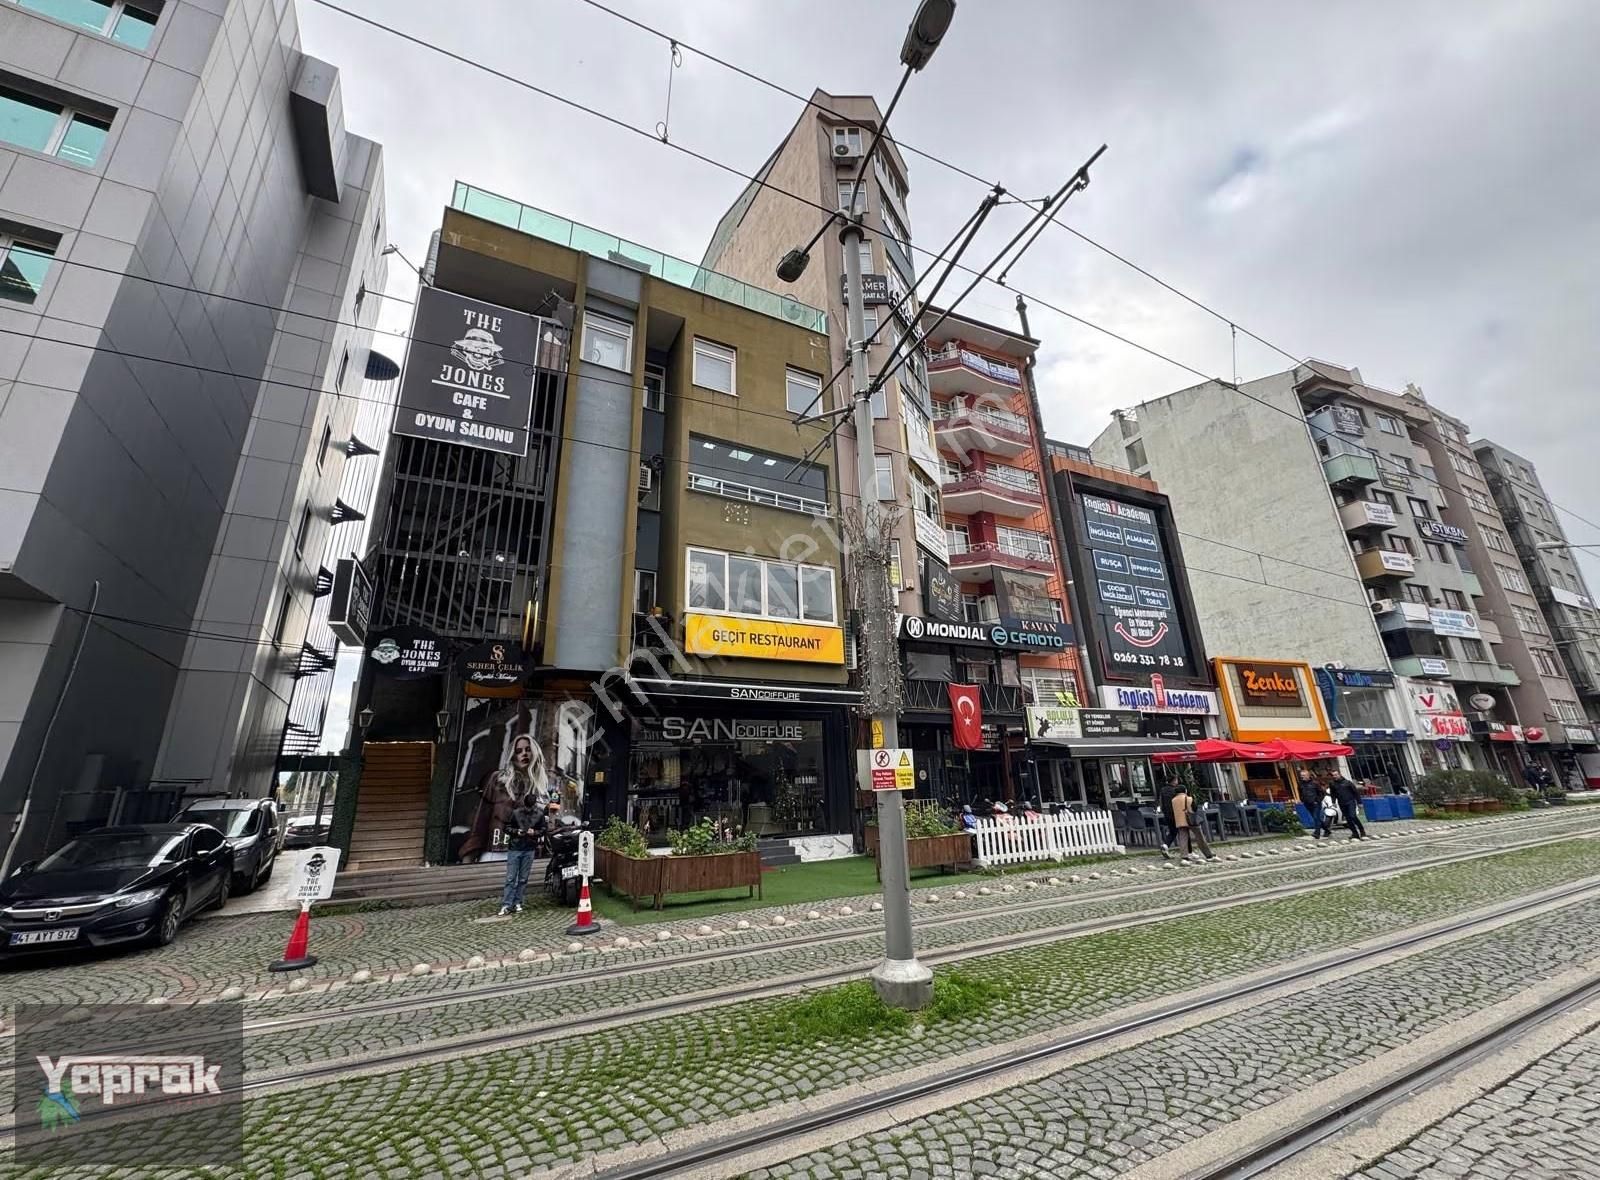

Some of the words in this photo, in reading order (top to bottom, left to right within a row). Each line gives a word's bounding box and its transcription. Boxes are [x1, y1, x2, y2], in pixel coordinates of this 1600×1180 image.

[463, 308, 503, 333] THE
[440, 364, 505, 393] JONES
[452, 391, 487, 411] CAFE
[462, 408, 474, 420] &
[415, 413, 456, 433] OYUN
[459, 421, 514, 444] SALONU
[1083, 497, 1111, 514] English
[1117, 506, 1151, 524] Academy
[1126, 534, 1155, 546] ALMANCA
[926, 622, 987, 641] MONDIAL
[1010, 631, 1063, 648] CFMOTO
[1021, 620, 1057, 633] KAVAN
[413, 639, 435, 650] THE
[712, 628, 746, 646] GEÇİT
[749, 631, 822, 650] RESTAURANT
[401, 649, 441, 660] JONES
[1113, 652, 1138, 664] 0262
[1139, 654, 1156, 665] 331
[1159, 655, 1170, 666] 78
[1173, 657, 1184, 667] 18
[467, 662, 495, 670] SEHER
[498, 662, 524, 672] ÇELİK
[1243, 670, 1297, 692] Zenka
[1118, 688, 1156, 709] English
[1166, 691, 1210, 713] Academy
[18, 933, 30, 943] 41
[35, 931, 55, 942] AYT
[57, 928, 76, 940] 972
